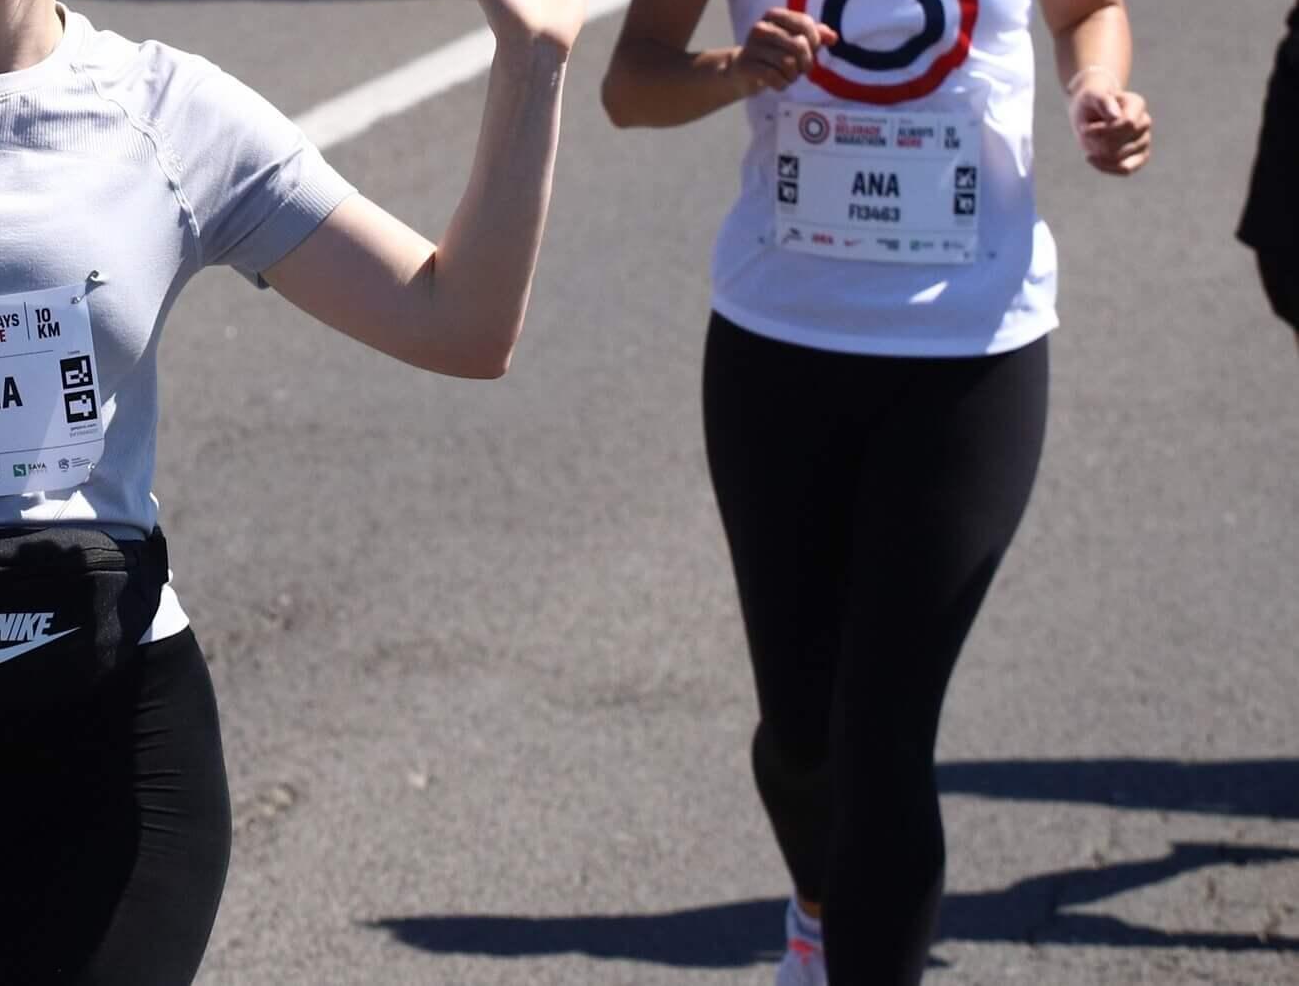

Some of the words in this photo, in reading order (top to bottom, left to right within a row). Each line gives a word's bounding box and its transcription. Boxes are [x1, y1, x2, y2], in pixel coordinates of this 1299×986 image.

[852, 171, 900, 198] ANA
[34, 307, 52, 324] 10
[37, 322, 61, 340] KM
